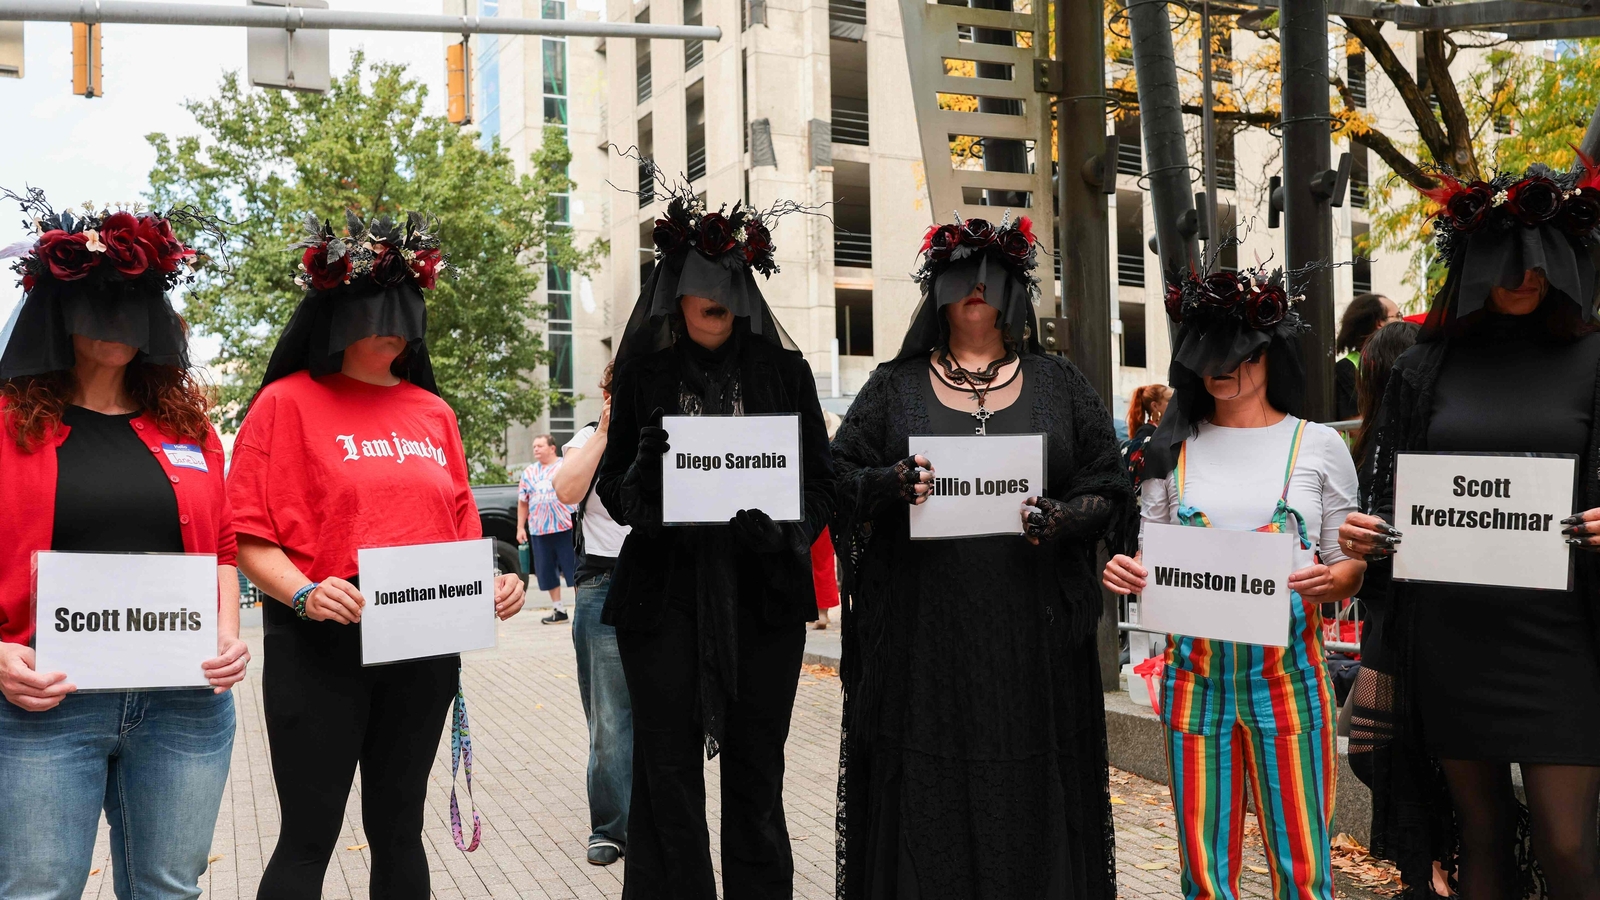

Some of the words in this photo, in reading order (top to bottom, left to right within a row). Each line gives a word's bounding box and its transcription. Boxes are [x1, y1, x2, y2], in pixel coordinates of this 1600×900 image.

[335, 433, 360, 462] I
[361, 438, 394, 457] am
[676, 452, 721, 472] Diego
[725, 452, 787, 469] Sarabia
[975, 477, 1029, 496] Lopes
[1452, 475, 1512, 499] Scott
[1410, 504, 1554, 532] Kretzschmar
[374, 587, 436, 606] Jonathan
[438, 580, 483, 600] Newell
[1154, 565, 1237, 593] Winston
[1240, 573, 1276, 596] Lee
[54, 607, 121, 633] Scott
[126, 607, 202, 632] Norris
